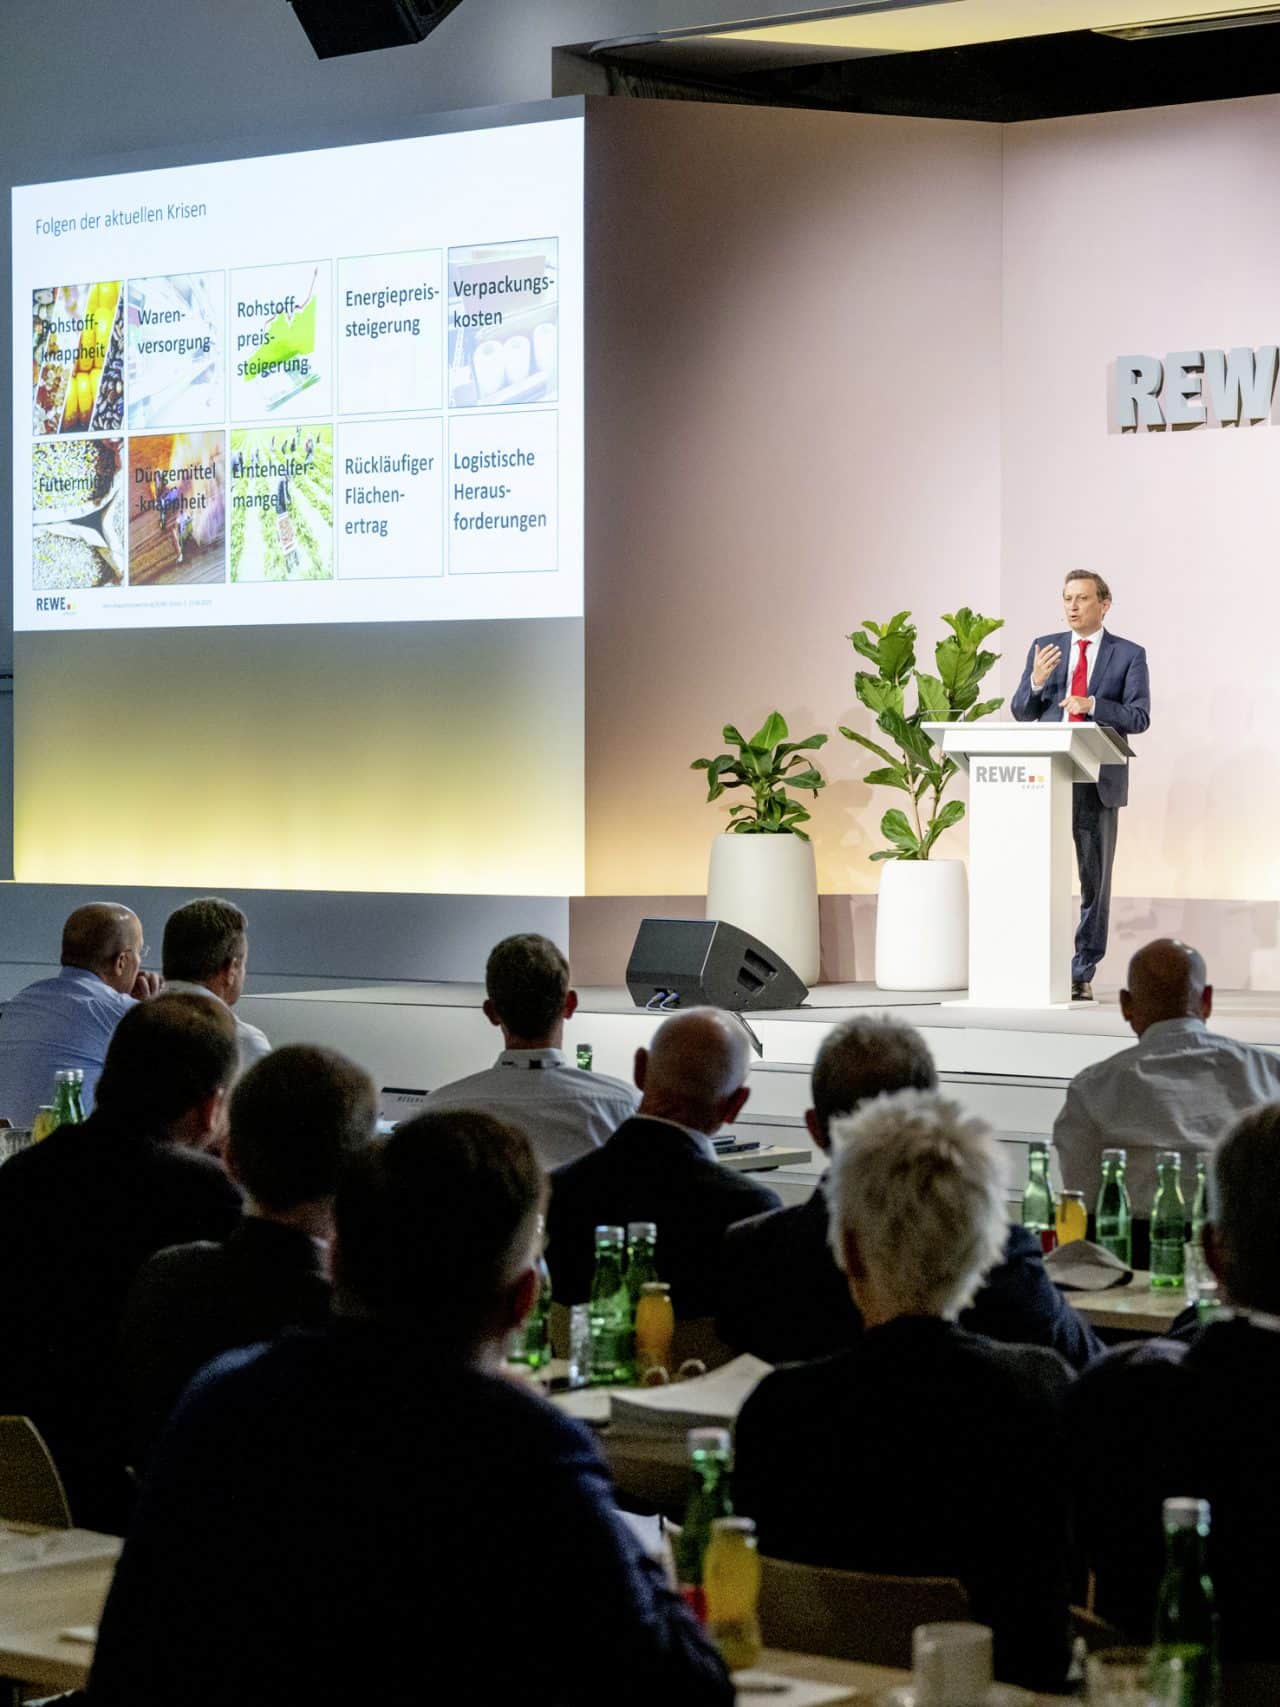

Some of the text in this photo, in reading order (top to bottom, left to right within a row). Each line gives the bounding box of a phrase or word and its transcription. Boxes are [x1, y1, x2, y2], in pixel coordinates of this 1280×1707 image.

[35, 202, 207, 237] Folgen der aktuellen Krisen
[345, 283, 440, 309] Energiepreis-
[453, 275, 555, 299] Verpackungs-
[137, 308, 187, 326] Waren-
[237, 295, 300, 319] Rohstoff-
[345, 318, 421, 339] steigerung
[453, 310, 503, 329] kosten
[137, 335, 211, 356] versorgung
[237, 329, 276, 351] preis-
[41, 342, 106, 364] knappheit
[237, 357, 309, 378] steigerung
[232, 457, 315, 479] Erntehelfer-
[345, 453, 435, 475] Rückläufiger
[454, 448, 535, 472] Logistische
[135, 463, 216, 485] Düngemittel
[345, 486, 406, 504] Flächen-
[454, 483, 512, 501] Heraus-
[345, 517, 389, 537] ertrag
[453, 512, 548, 533] forderungen
[36, 596, 66, 611] REWE
[975, 766, 1027, 783] REWE
